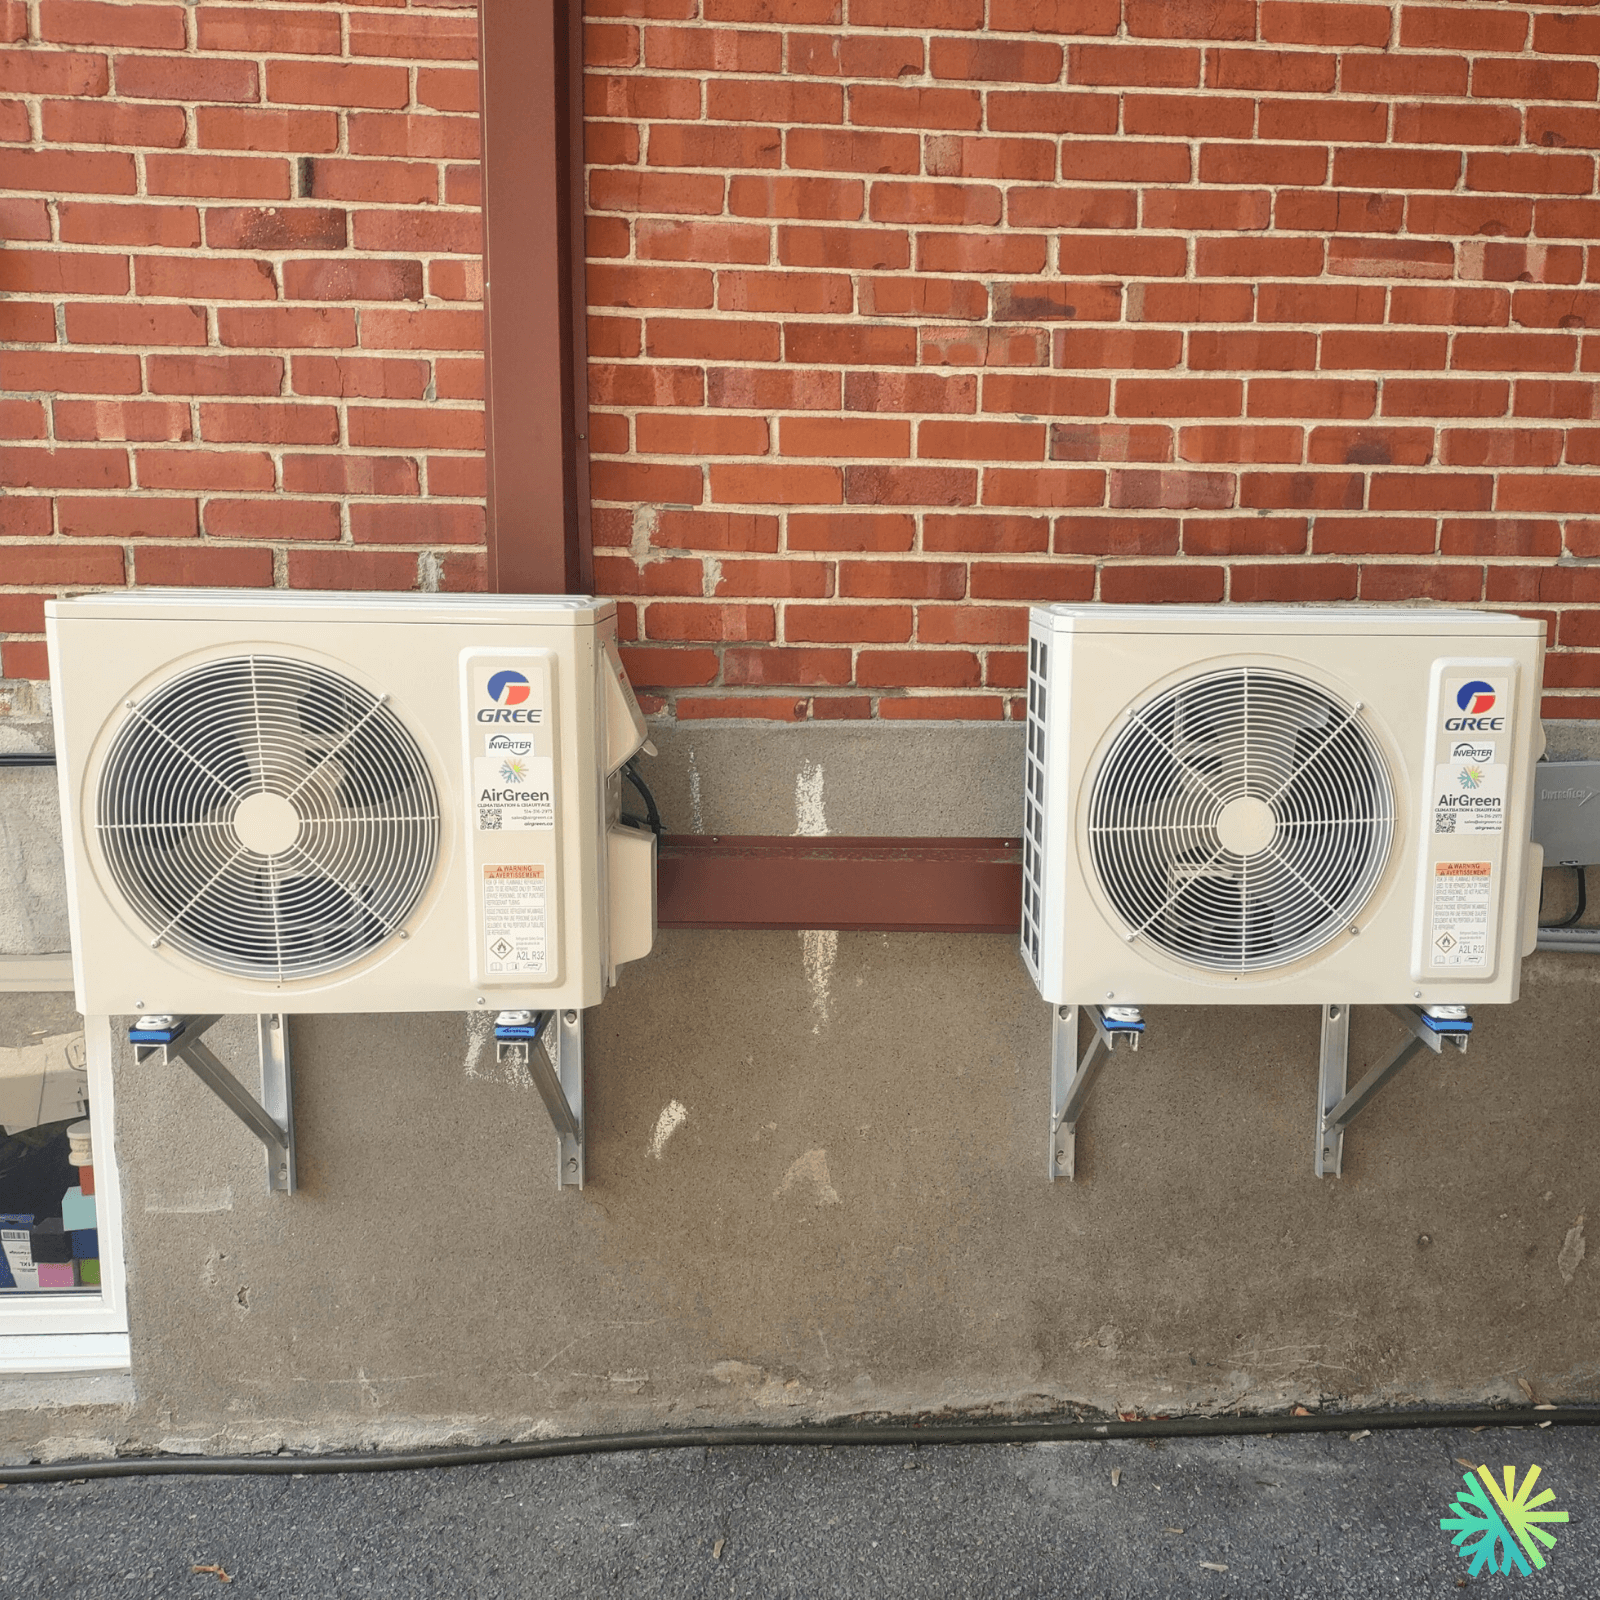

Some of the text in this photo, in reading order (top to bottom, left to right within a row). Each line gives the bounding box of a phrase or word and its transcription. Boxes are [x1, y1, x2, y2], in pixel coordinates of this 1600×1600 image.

[477, 708, 542, 723] GREE
[1444, 717, 1505, 731] GREE
[488, 741, 532, 749] INVERTER
[1453, 749, 1493, 757] INVERTER
[480, 788, 549, 801] AirGreen
[1438, 794, 1501, 807] AirGreen
[1458, 944, 1484, 954] A2L R32
[516, 950, 544, 960] A2L R32
